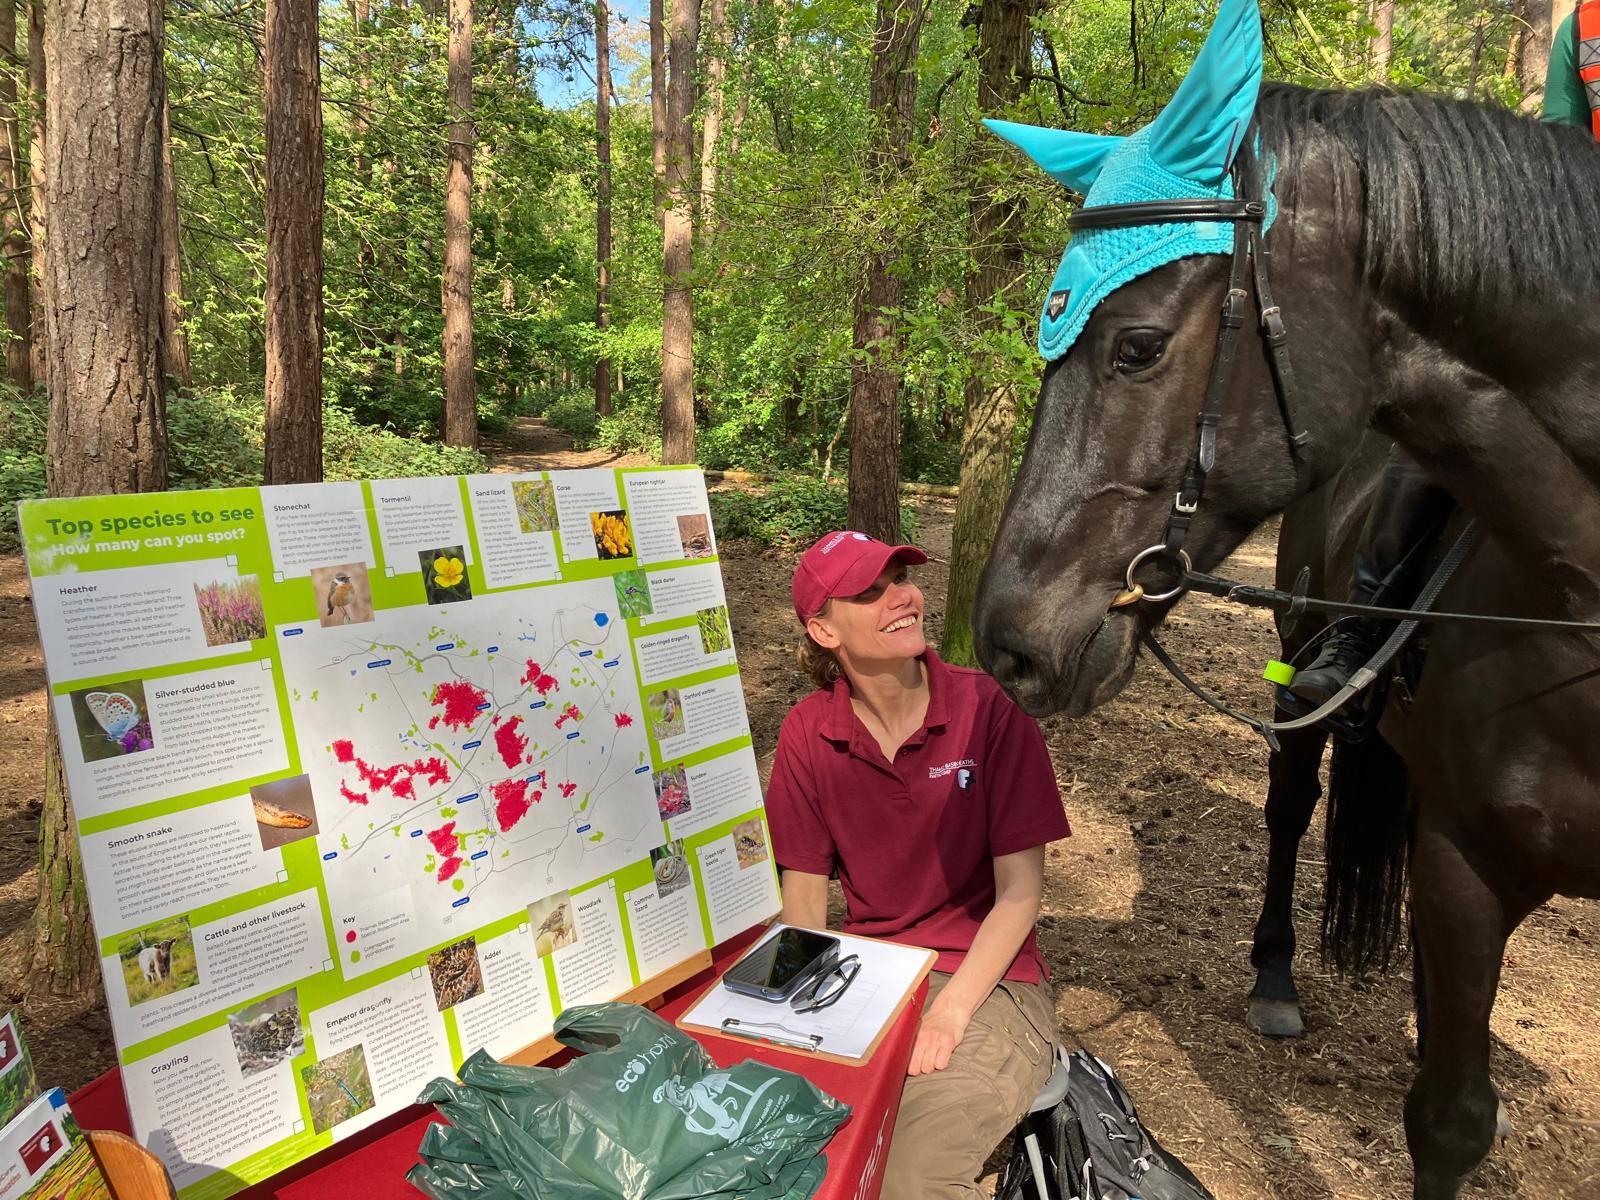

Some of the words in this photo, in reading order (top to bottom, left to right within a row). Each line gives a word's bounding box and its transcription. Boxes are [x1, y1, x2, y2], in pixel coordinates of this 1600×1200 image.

[380, 495, 411, 503] Tormentil
[273, 503, 310, 512] Stonechat
[46, 518, 93, 538] Top
[101, 510, 187, 534] species
[192, 508, 214, 524] to
[220, 507, 255, 521] see
[51, 542, 90, 556] How
[96, 537, 140, 553] many
[144, 534, 173, 548] can
[176, 532, 204, 549] you
[207, 527, 246, 544] spot?
[59, 585, 97, 595] Heather
[640, 638, 671, 649] Golden-ringed
[670, 633, 690, 643] dragonfly
[155, 681, 216, 699] Silver-studded
[216, 679, 235, 687] blue
[683, 691, 701, 701] Dartford
[690, 772, 707, 781] Sundew
[107, 833, 144, 849] Smooth
[146, 826, 172, 839] snake
[577, 897, 602, 912] Woodlark
[634, 892, 654, 907] Common
[635, 903, 648, 914] lizard
[204, 928, 230, 941] Cattle
[231, 921, 247, 932] and
[248, 914, 270, 926] other
[271, 902, 306, 918] livestock
[342, 915, 356, 926] Key
[483, 949, 501, 961] Adder
[326, 1011, 357, 1028] Emperor
[358, 996, 392, 1015] dragonfly
[150, 1055, 189, 1074] Grayling
